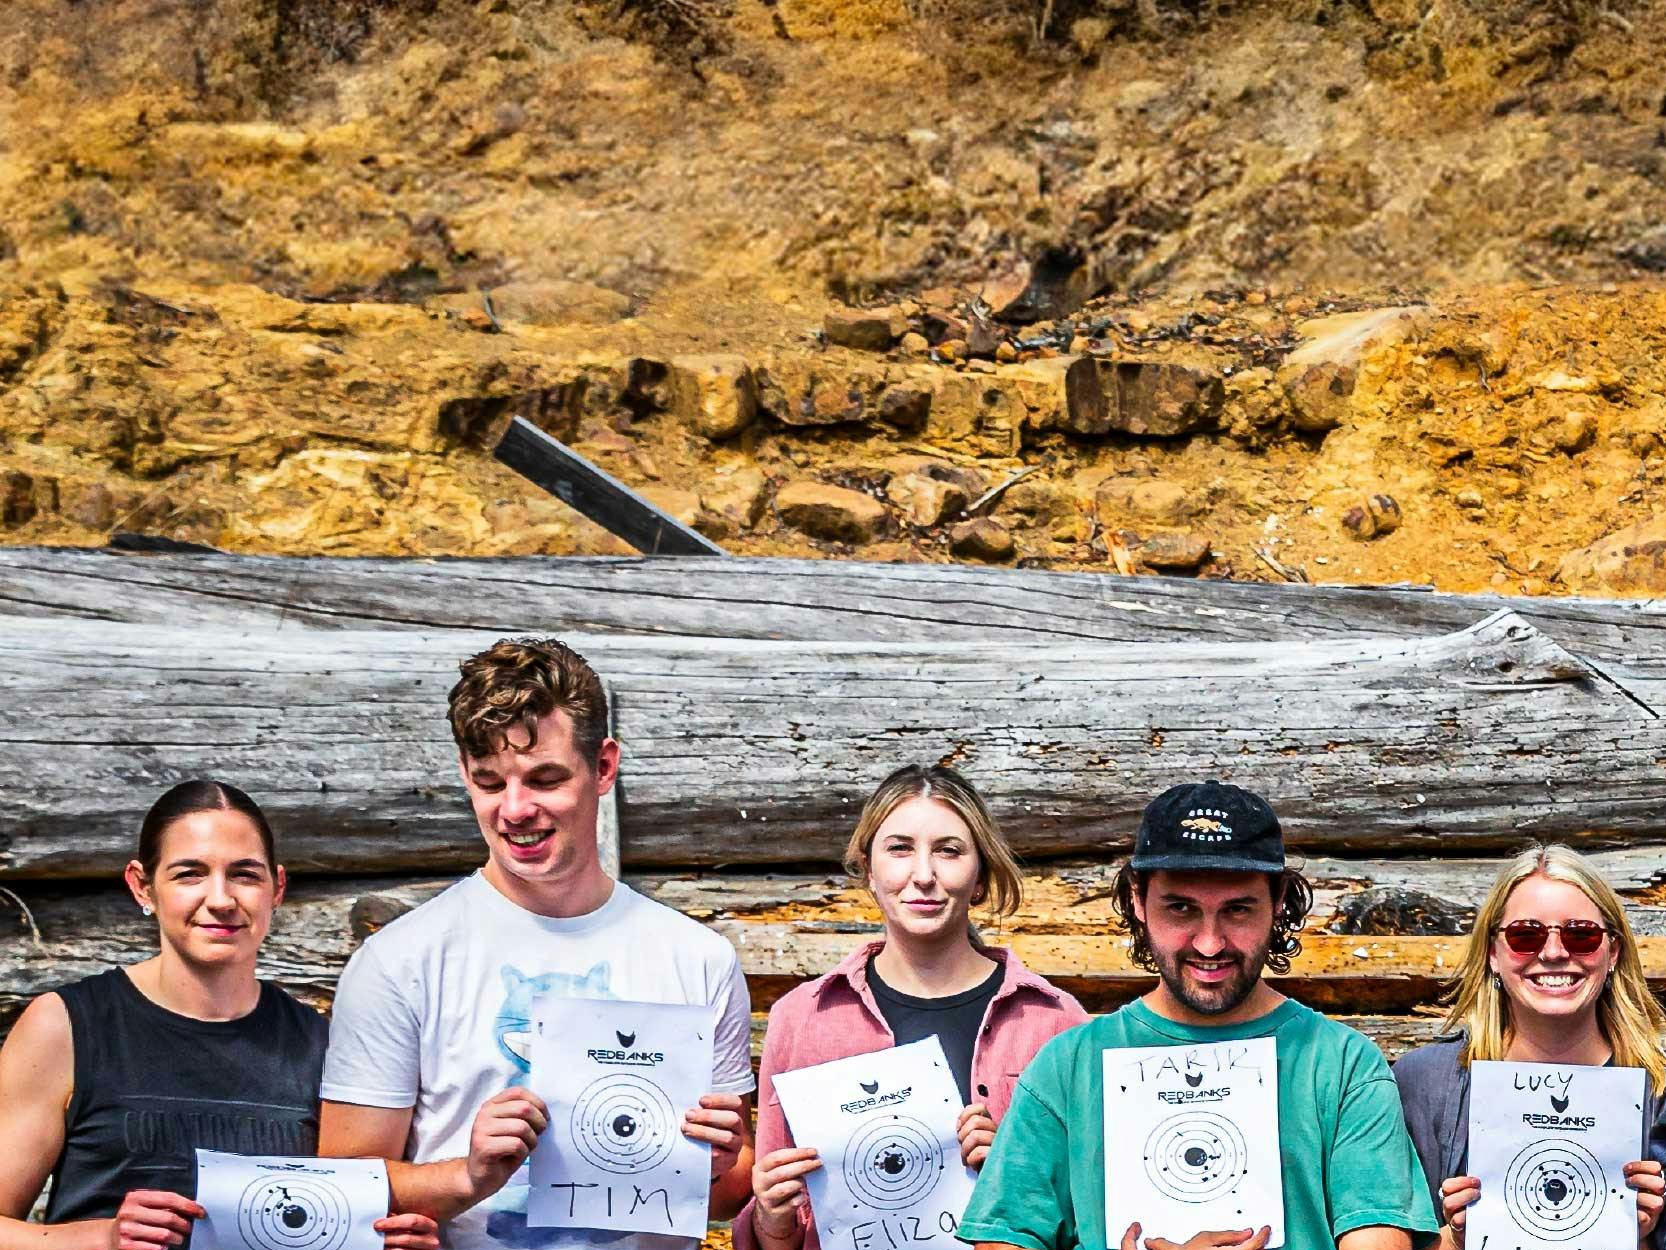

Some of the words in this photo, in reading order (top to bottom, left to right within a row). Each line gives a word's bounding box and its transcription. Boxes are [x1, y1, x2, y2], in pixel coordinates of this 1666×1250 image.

[587, 1049, 664, 1064] REDBANKS
[1157, 1087, 1231, 1102] REDBANKS
[1514, 1072, 1574, 1097] LUCY
[839, 1086, 912, 1113] REDBANKS
[1522, 1113, 1596, 1128] REDBANKS
[551, 1182, 673, 1227] TIM
